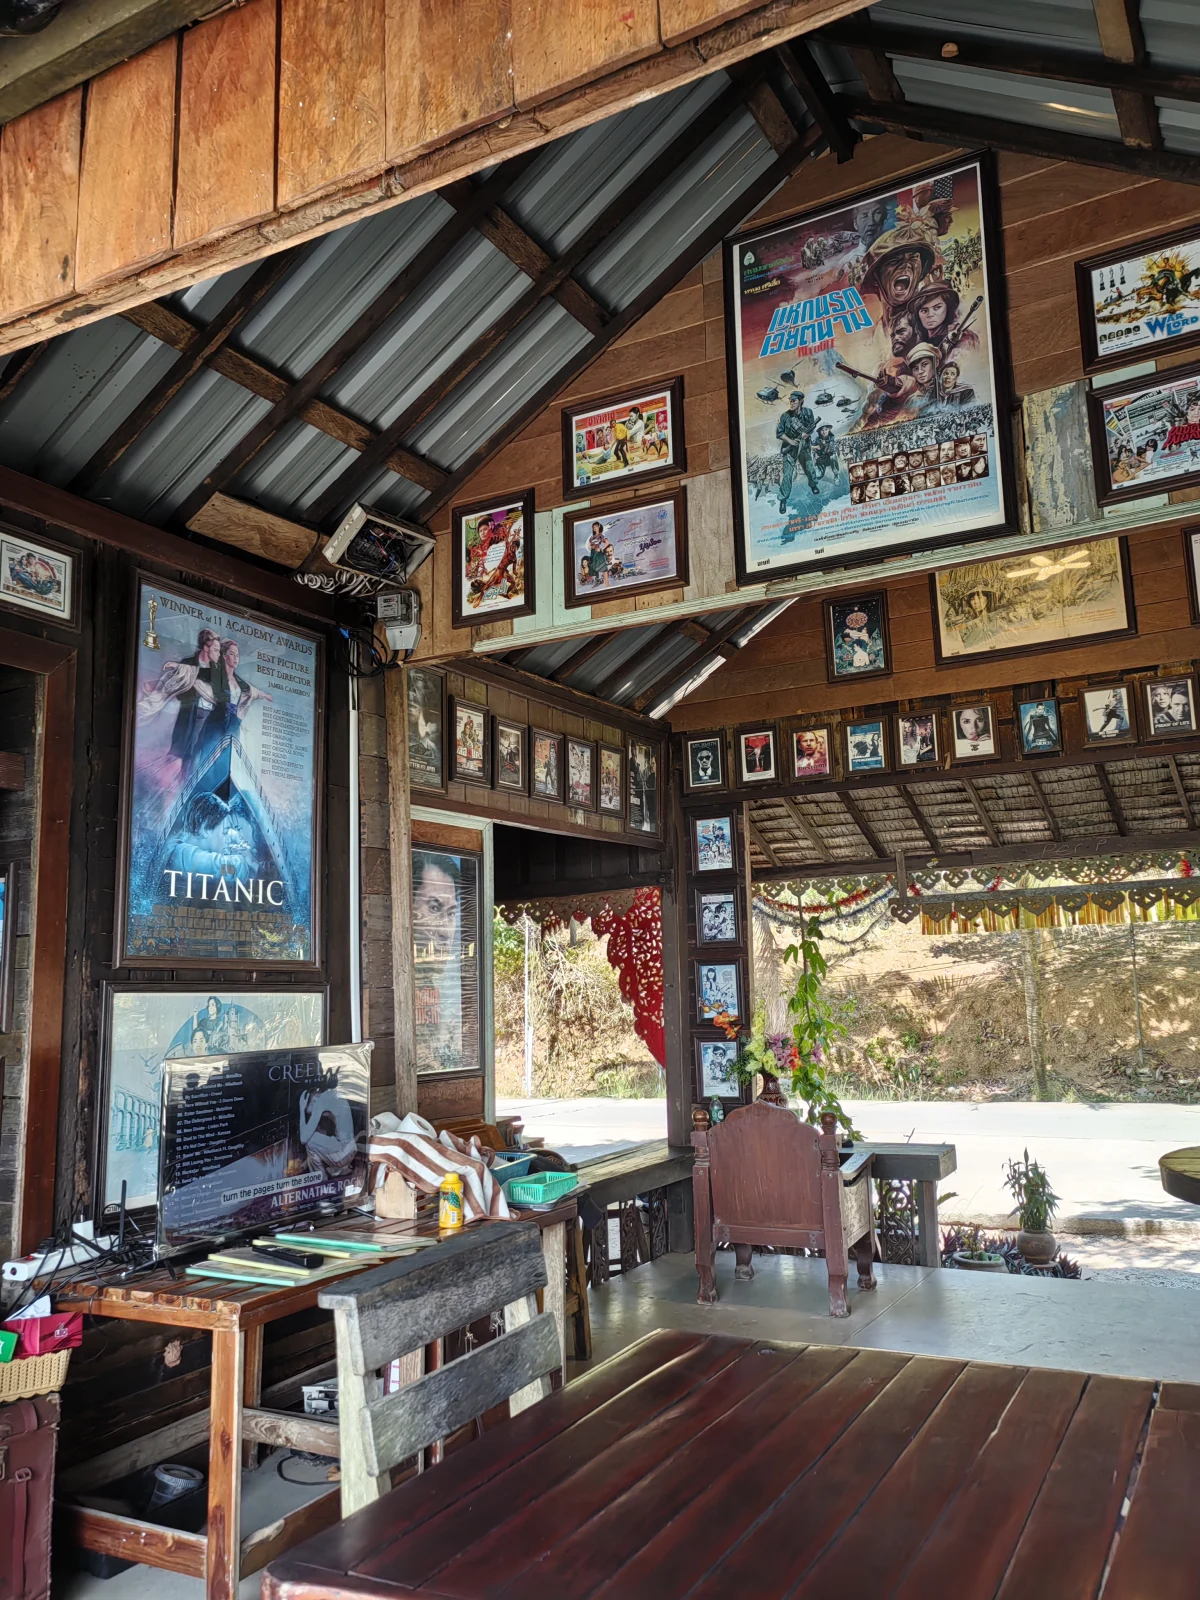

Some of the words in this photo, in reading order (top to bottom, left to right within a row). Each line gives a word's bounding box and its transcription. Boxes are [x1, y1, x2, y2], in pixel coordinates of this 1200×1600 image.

[767, 286, 865, 333] แหกนรก
[1144, 312, 1183, 338] WAR
[1167, 316, 1199, 336] LORD
[159, 596, 204, 620] WINNER
[213, 615, 222, 626] 11
[225, 621, 274, 642] ACADEMY
[275, 635, 313, 656] AWARDS
[256, 665, 275, 677] BEST
[277, 670, 311, 687] DIRECTOR
[257, 652, 275, 665] BEST
[277, 657, 310, 674] PICTURE
[268, 681, 284, 693] JAMES
[285, 685, 311, 697] CAMERON
[164, 869, 283, 906] TITANIC
[223, 1192, 238, 1202] turn
[240, 1188, 251, 1198] the
[253, 1184, 275, 1196] pages
[276, 1180, 290, 1189] turn
[291, 1176, 302, 1186] the
[303, 1174, 321, 1184] stone
[270, 1183, 336, 1209] ALTERNATIVE
